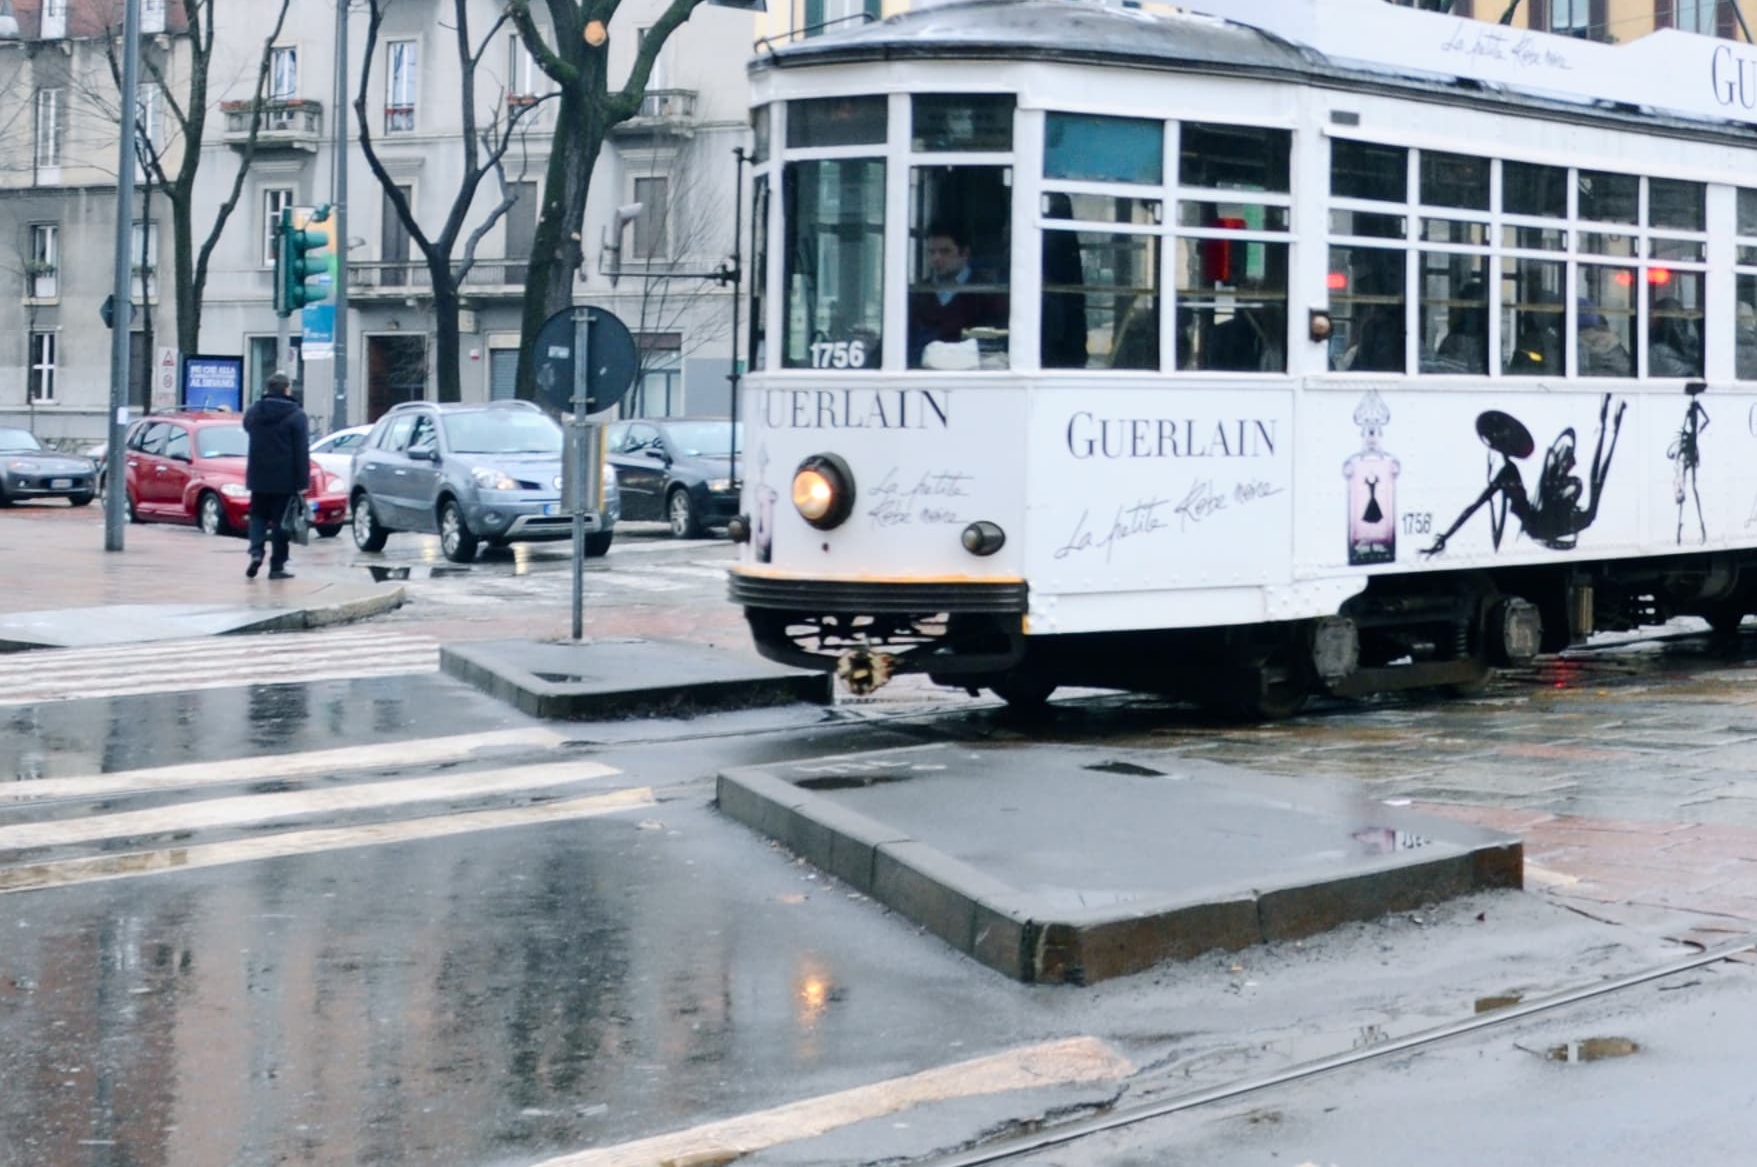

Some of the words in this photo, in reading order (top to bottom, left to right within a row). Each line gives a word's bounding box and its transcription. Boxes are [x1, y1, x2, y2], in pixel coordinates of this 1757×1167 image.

[810, 340, 865, 369] 1756
[757, 389, 951, 429] UERLAIN
[1066, 410, 1278, 459] GUERLAIN
[1053, 507, 1093, 560] La
[1095, 494, 1171, 565] petite
[1402, 512, 1432, 535] 1756
